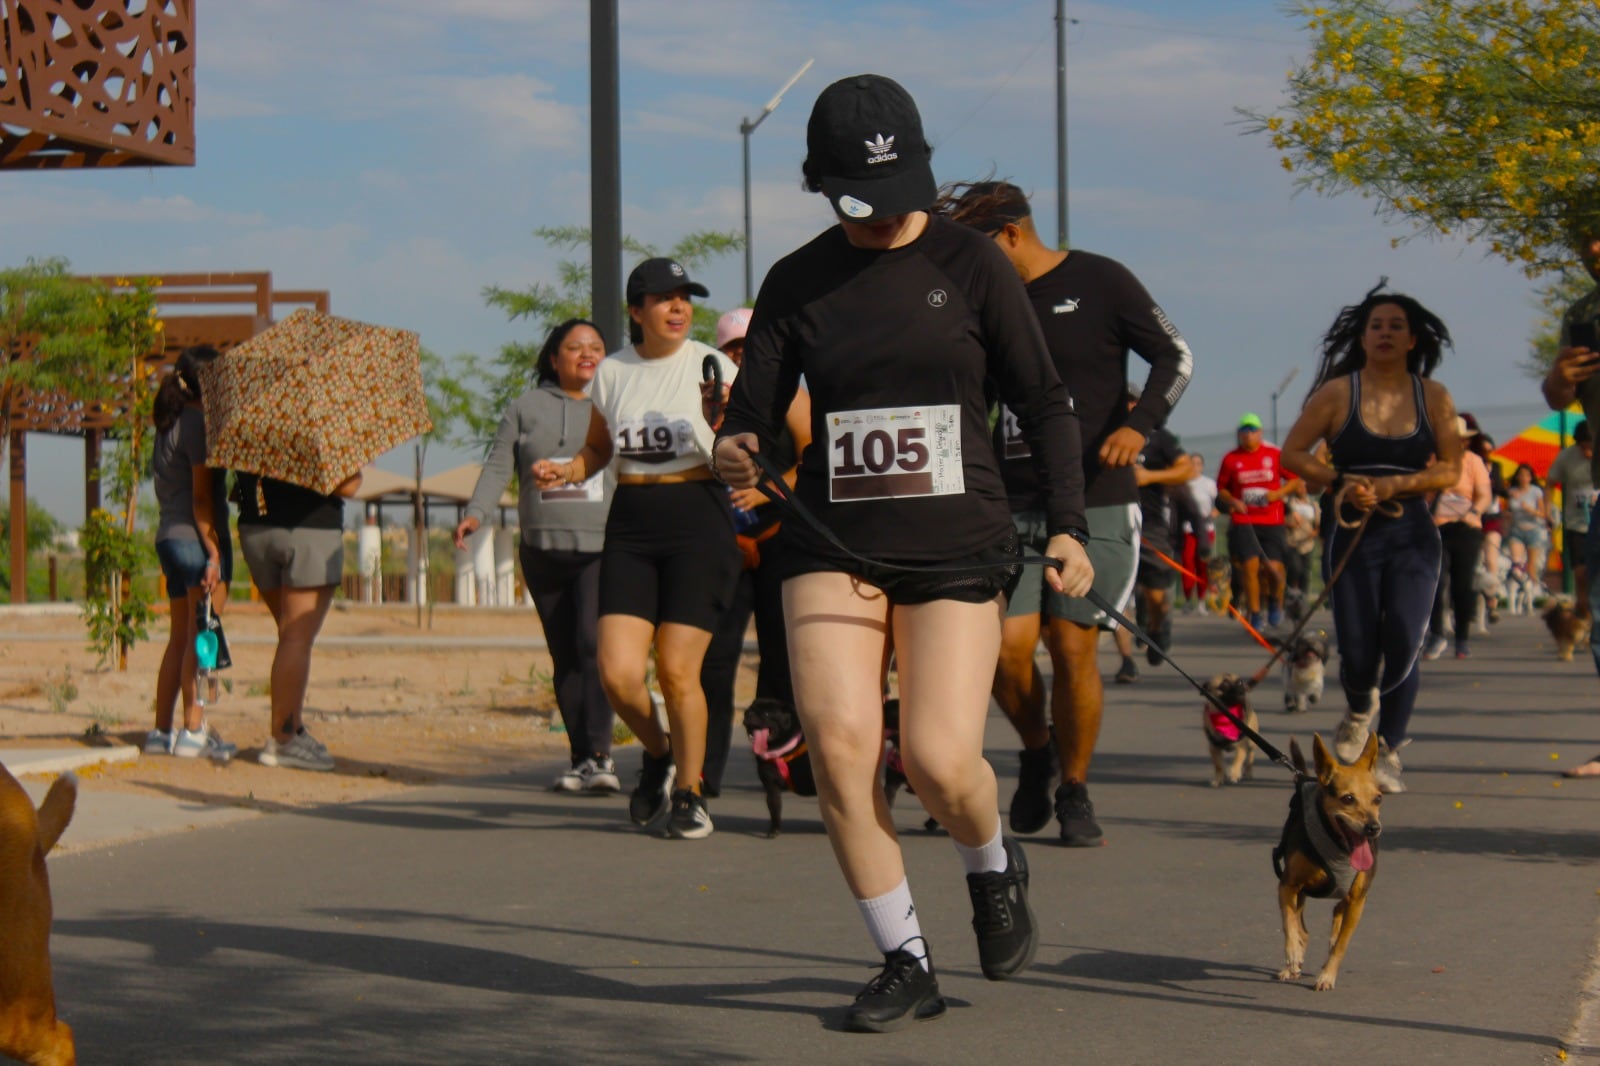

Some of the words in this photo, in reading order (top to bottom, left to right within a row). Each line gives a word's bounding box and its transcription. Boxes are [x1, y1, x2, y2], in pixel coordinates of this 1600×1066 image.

[867, 152, 898, 164] adidas
[618, 426, 673, 452] 119
[834, 427, 930, 477] 105
